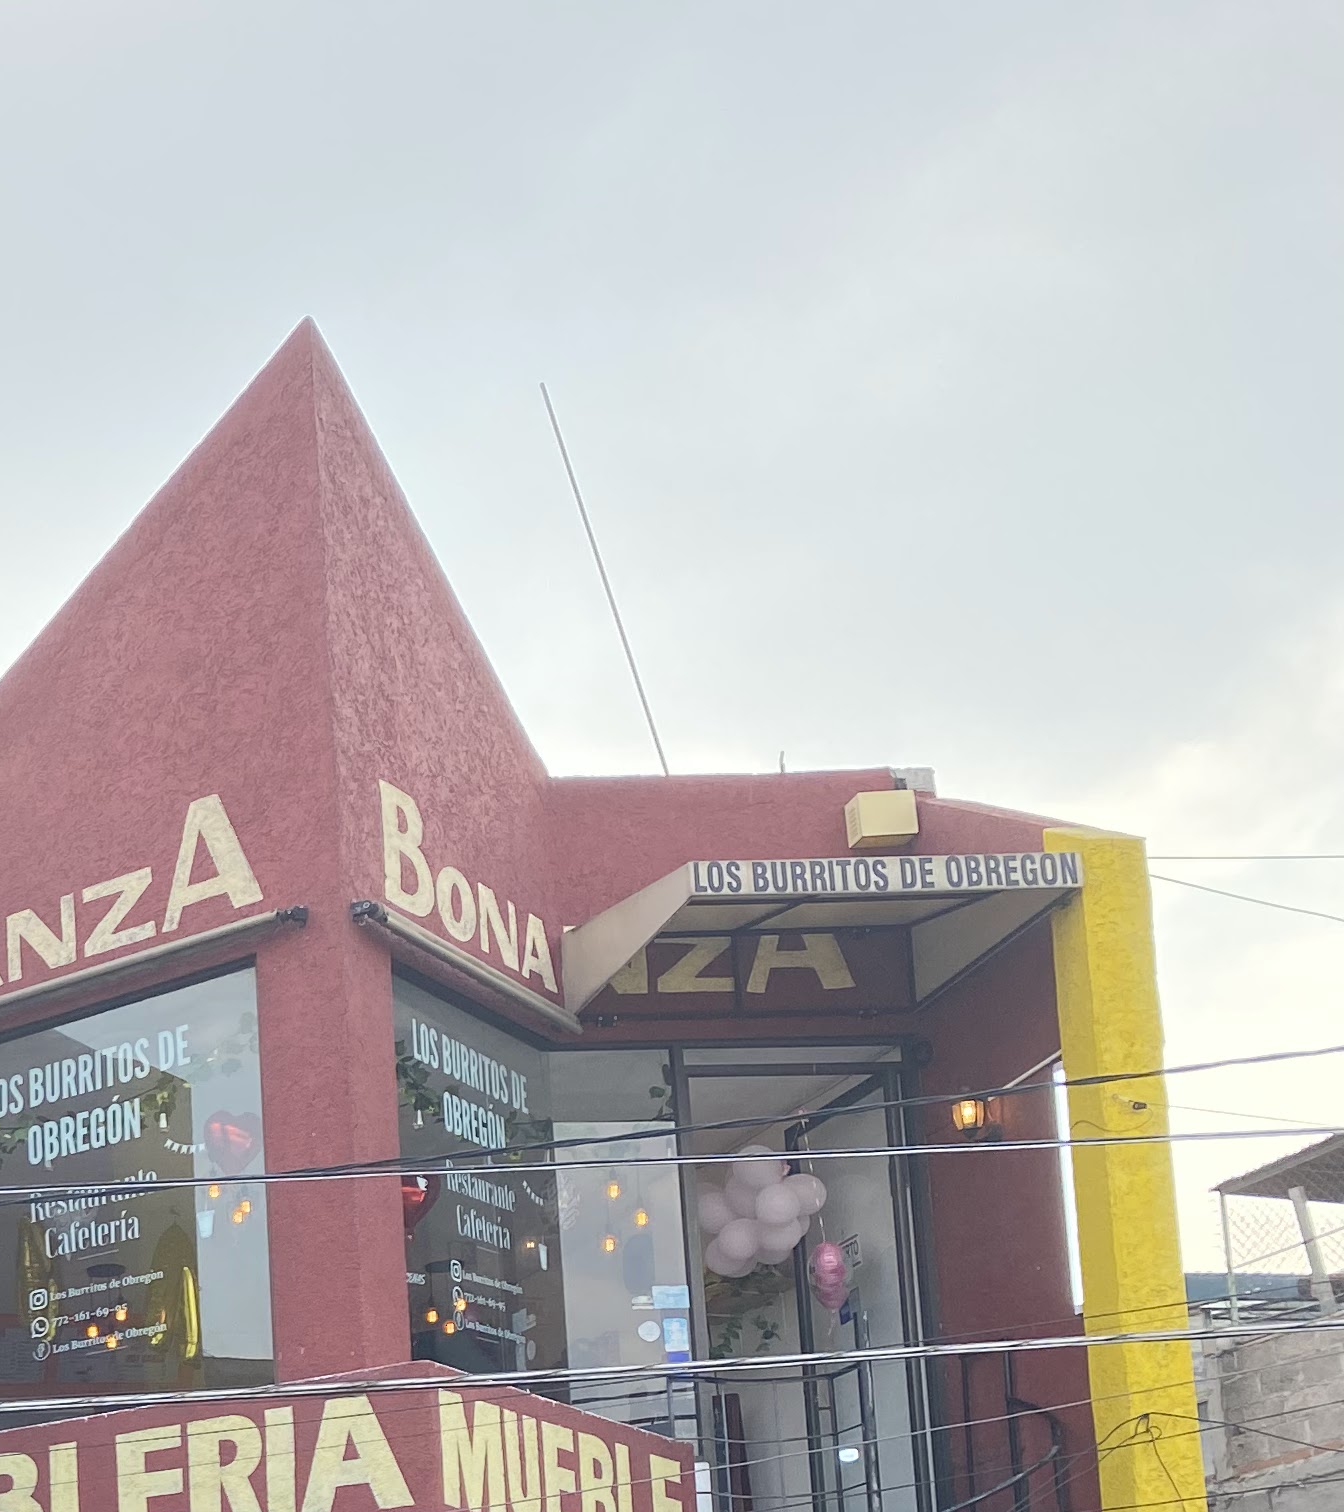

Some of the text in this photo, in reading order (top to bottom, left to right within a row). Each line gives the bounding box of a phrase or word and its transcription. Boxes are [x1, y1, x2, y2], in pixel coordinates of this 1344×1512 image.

[693, 861, 742, 894] LOS
[753, 859, 890, 893] BURRITOS
[901, 855, 936, 890] DE
[28, 1038, 150, 1109] BURRITOS
[158, 1024, 192, 1073] DE
[411, 1018, 529, 1115] LOS BURRITOS DE
[26, 1094, 142, 1166] OBREGÓN
[443, 1091, 507, 1150] OBREGÓN
[45, 1211, 141, 1260] Cafetería
[456, 1204, 511, 1251] Cafetería
[68, 1281, 107, 1298] Burritos
[109, 1278, 121, 1289] de
